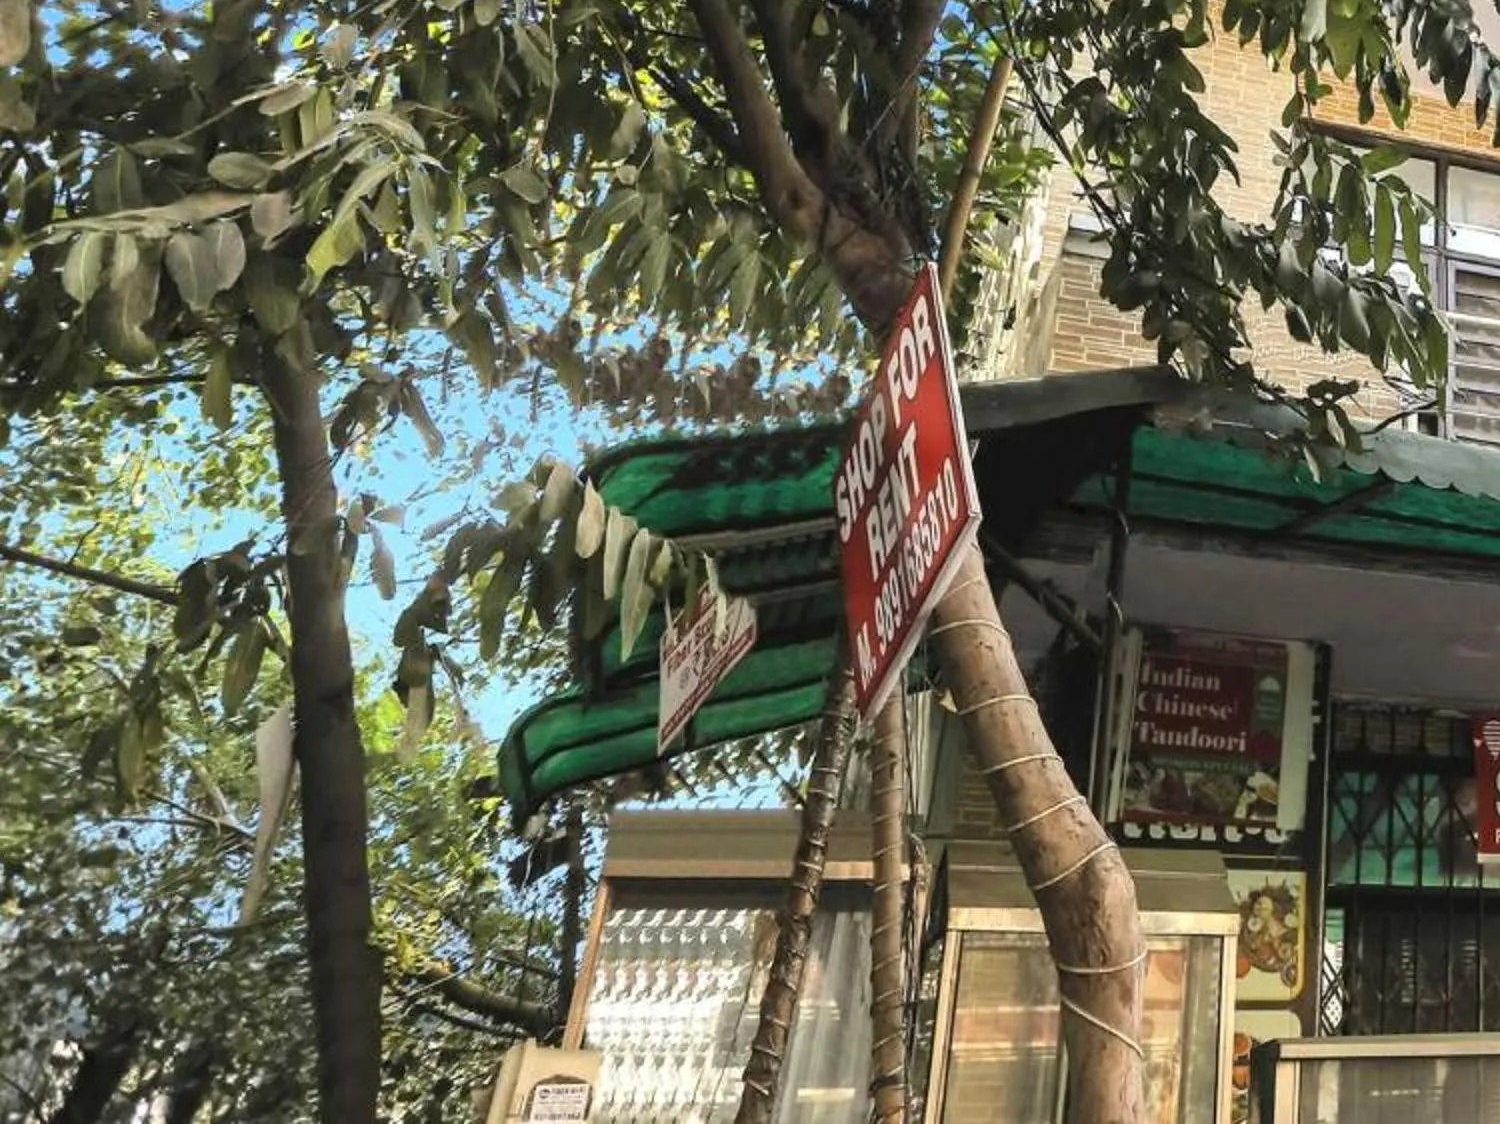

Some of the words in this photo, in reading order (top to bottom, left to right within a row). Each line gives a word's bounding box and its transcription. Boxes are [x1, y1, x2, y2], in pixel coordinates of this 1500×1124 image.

[836, 393, 886, 543] SHOP
[888, 294, 934, 429] FOR
[866, 420, 921, 582] RENT
[874, 457, 959, 656] 9891685810
[1137, 690, 1234, 721] Chinese
[1139, 662, 1221, 692] Indian
[1134, 721, 1248, 753] Tandoori
